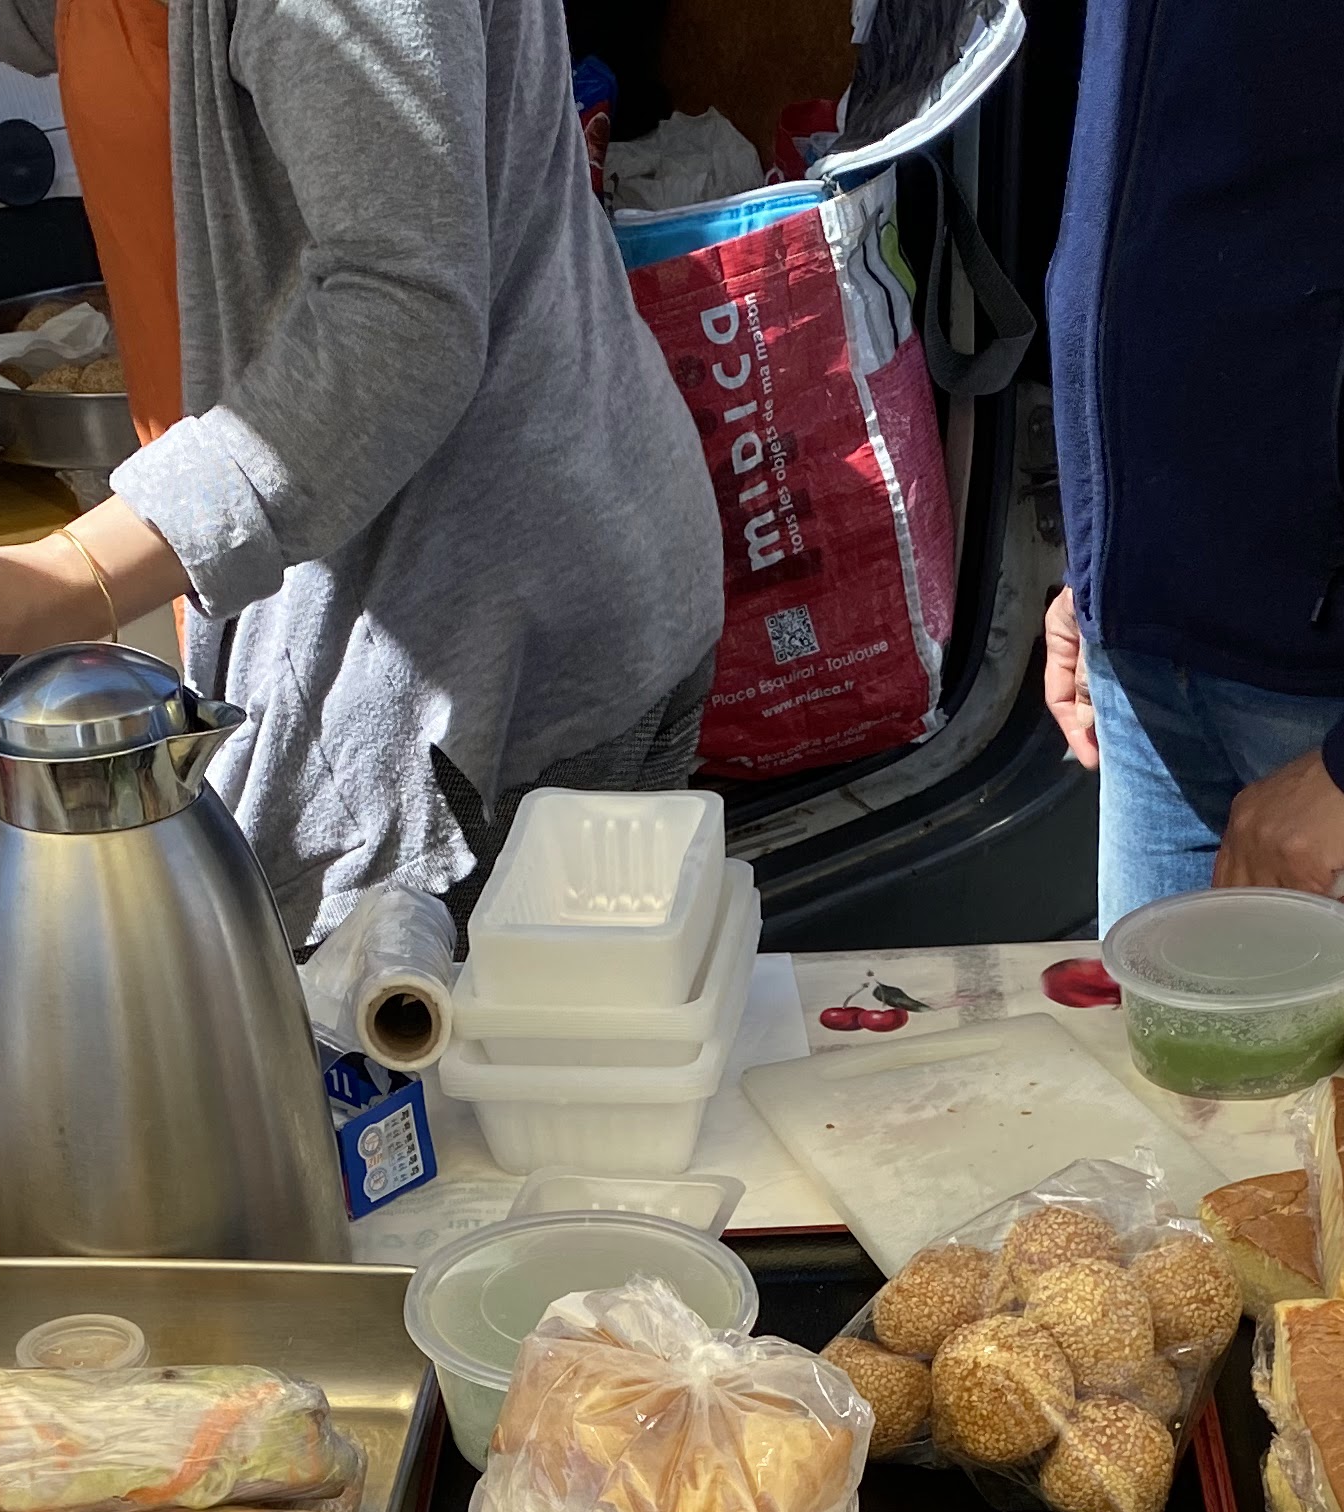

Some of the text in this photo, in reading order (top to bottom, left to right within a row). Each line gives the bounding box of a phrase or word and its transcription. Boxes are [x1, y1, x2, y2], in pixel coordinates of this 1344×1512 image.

[744, 292, 805, 555] tous les objets de ma maison
[711, 686, 756, 708] Place
[826, 640, 889, 672] Toulouse
[760, 679, 855, 719] www.midica.fr
[757, 751, 786, 764] Mon
